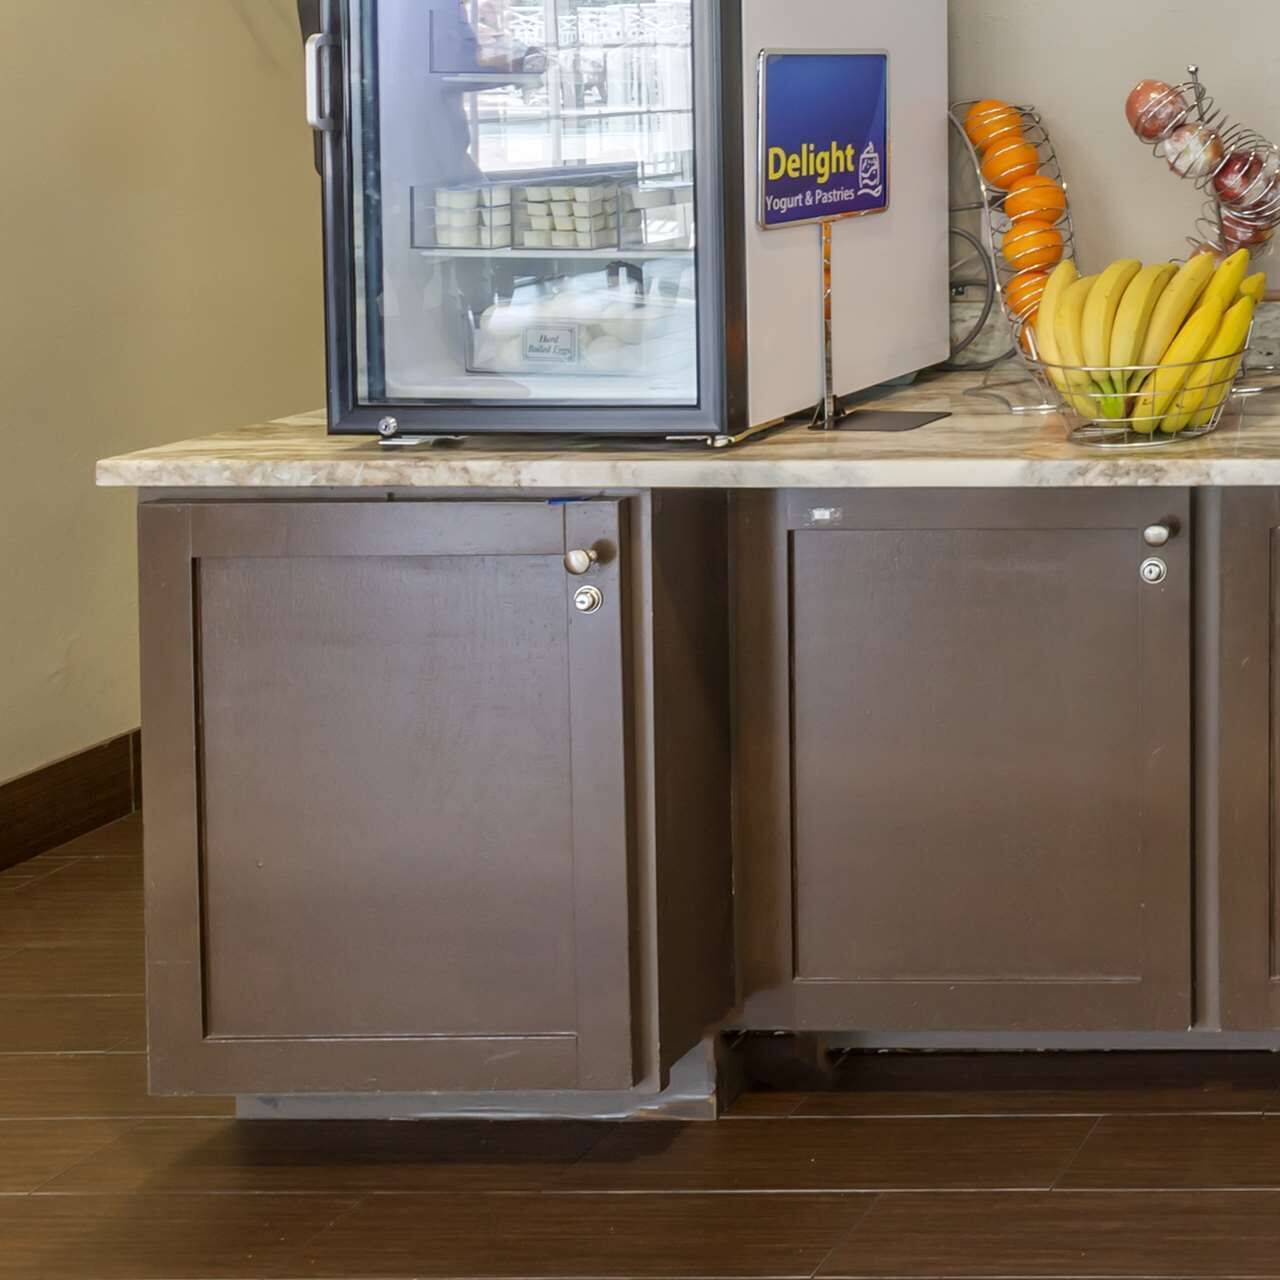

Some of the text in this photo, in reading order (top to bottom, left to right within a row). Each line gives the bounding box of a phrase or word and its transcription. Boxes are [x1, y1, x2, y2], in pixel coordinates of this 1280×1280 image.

[767, 141, 855, 184] Delight
[766, 186, 855, 213] Yogurt & Pastries
